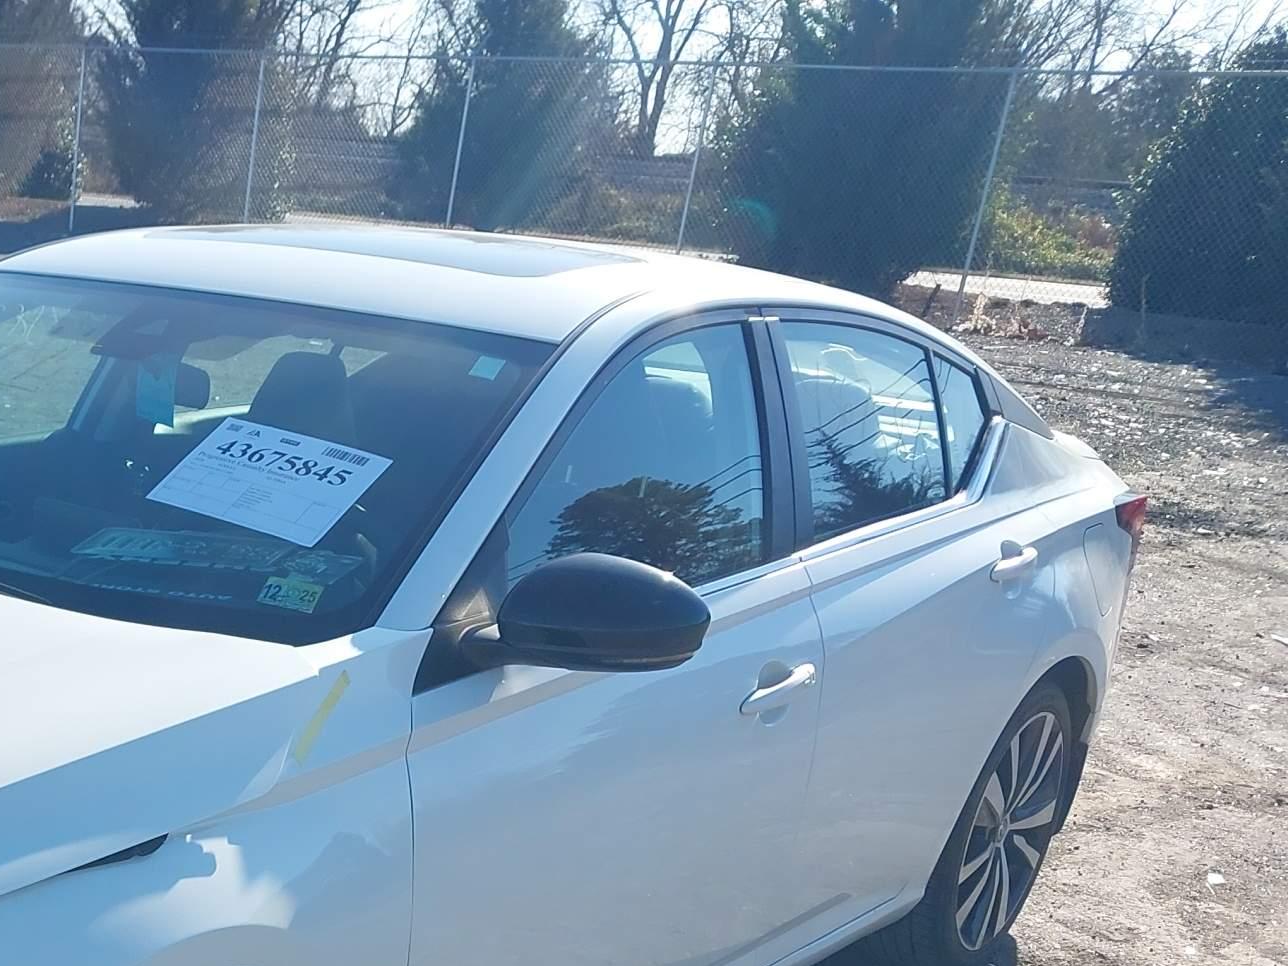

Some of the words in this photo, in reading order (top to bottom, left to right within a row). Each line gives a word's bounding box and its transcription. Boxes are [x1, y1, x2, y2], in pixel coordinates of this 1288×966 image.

[215, 439, 354, 487] 43675845
[263, 583, 282, 601] 12
[299, 590, 319, 603] 25
